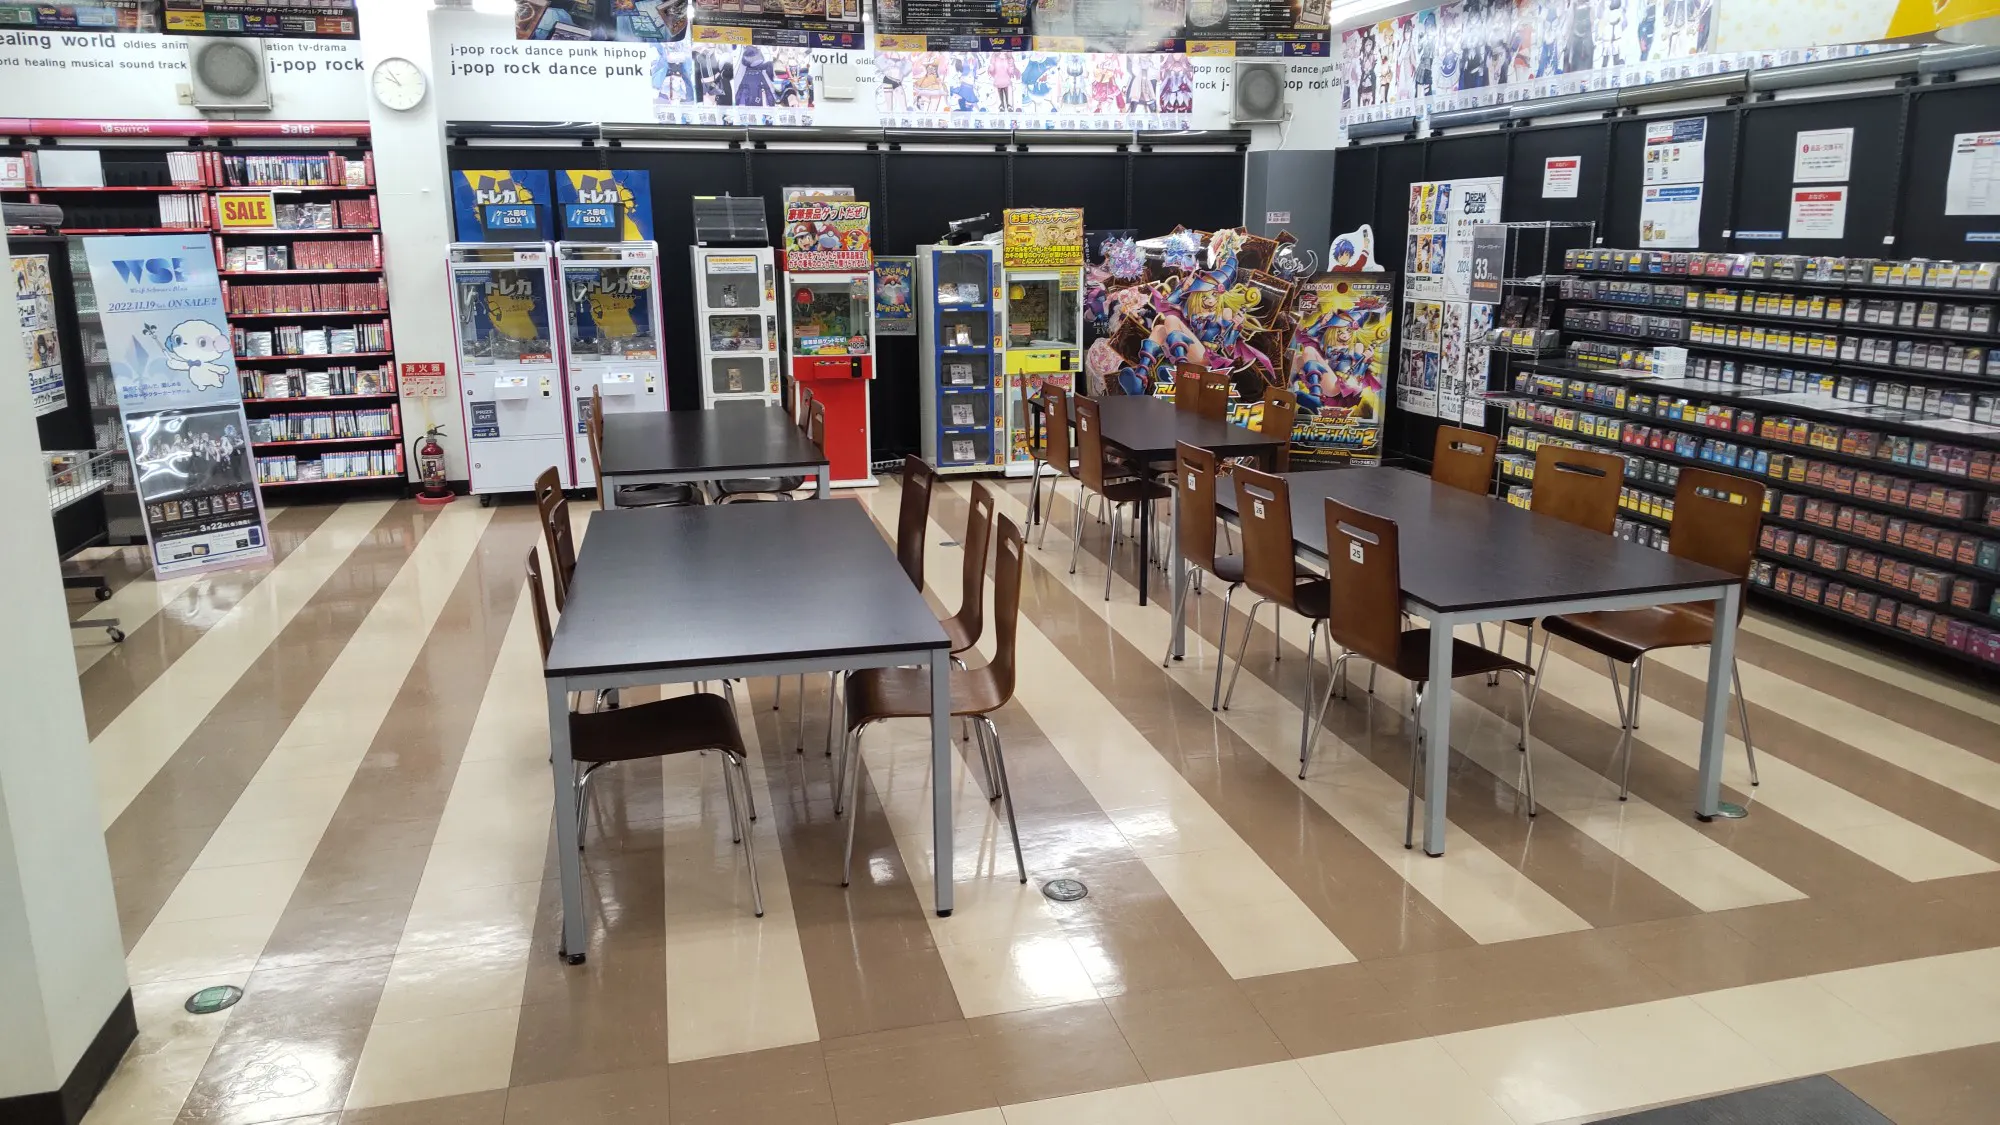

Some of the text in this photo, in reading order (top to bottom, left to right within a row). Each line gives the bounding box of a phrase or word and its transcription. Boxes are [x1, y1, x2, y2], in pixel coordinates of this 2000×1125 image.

[0, 32, 189, 50] ealing world oldies anim
[267, 43, 347, 52] ation tv-drama
[451, 44, 646, 59] j-pop rock dance punk hiphop
[25, 58, 66, 69] healing
[71, 59, 114, 68] musical
[120, 60, 154, 69] sound
[158, 60, 187, 69] track
[270, 58, 365, 73] j-pop rock
[451, 61, 643, 78] j-pop rock dance punk
[1291, 65, 1318, 74] dance
[1195, 81, 1216, 89] rock
[1308, 79, 1328, 89] rock
[281, 124, 316, 134] Sale!
[476, 189, 518, 203] トレカ
[579, 189, 618, 203] トレカ
[1465, 192, 1487, 203] DREAM
[224, 201, 267, 220] SALE
[496, 209, 527, 217] ケース回収
[1464, 203, 1486, 214] ORDER
[1010, 211, 1078, 223] お宝キャッチャー
[485, 278, 532, 296] トレカ
[766, 290, 773, 299] A
[994, 288, 1000, 297] 6
[108, 301, 156, 311] 2022.11.19
[168, 299, 184, 308] ON
[995, 338, 1000, 346] 7
[406, 364, 441, 373] 消火器
[995, 379, 1000, 387] 8
[995, 418, 1001, 427] 9
[1255, 506, 1263, 515] 26
[1352, 549, 1361, 558] 25
